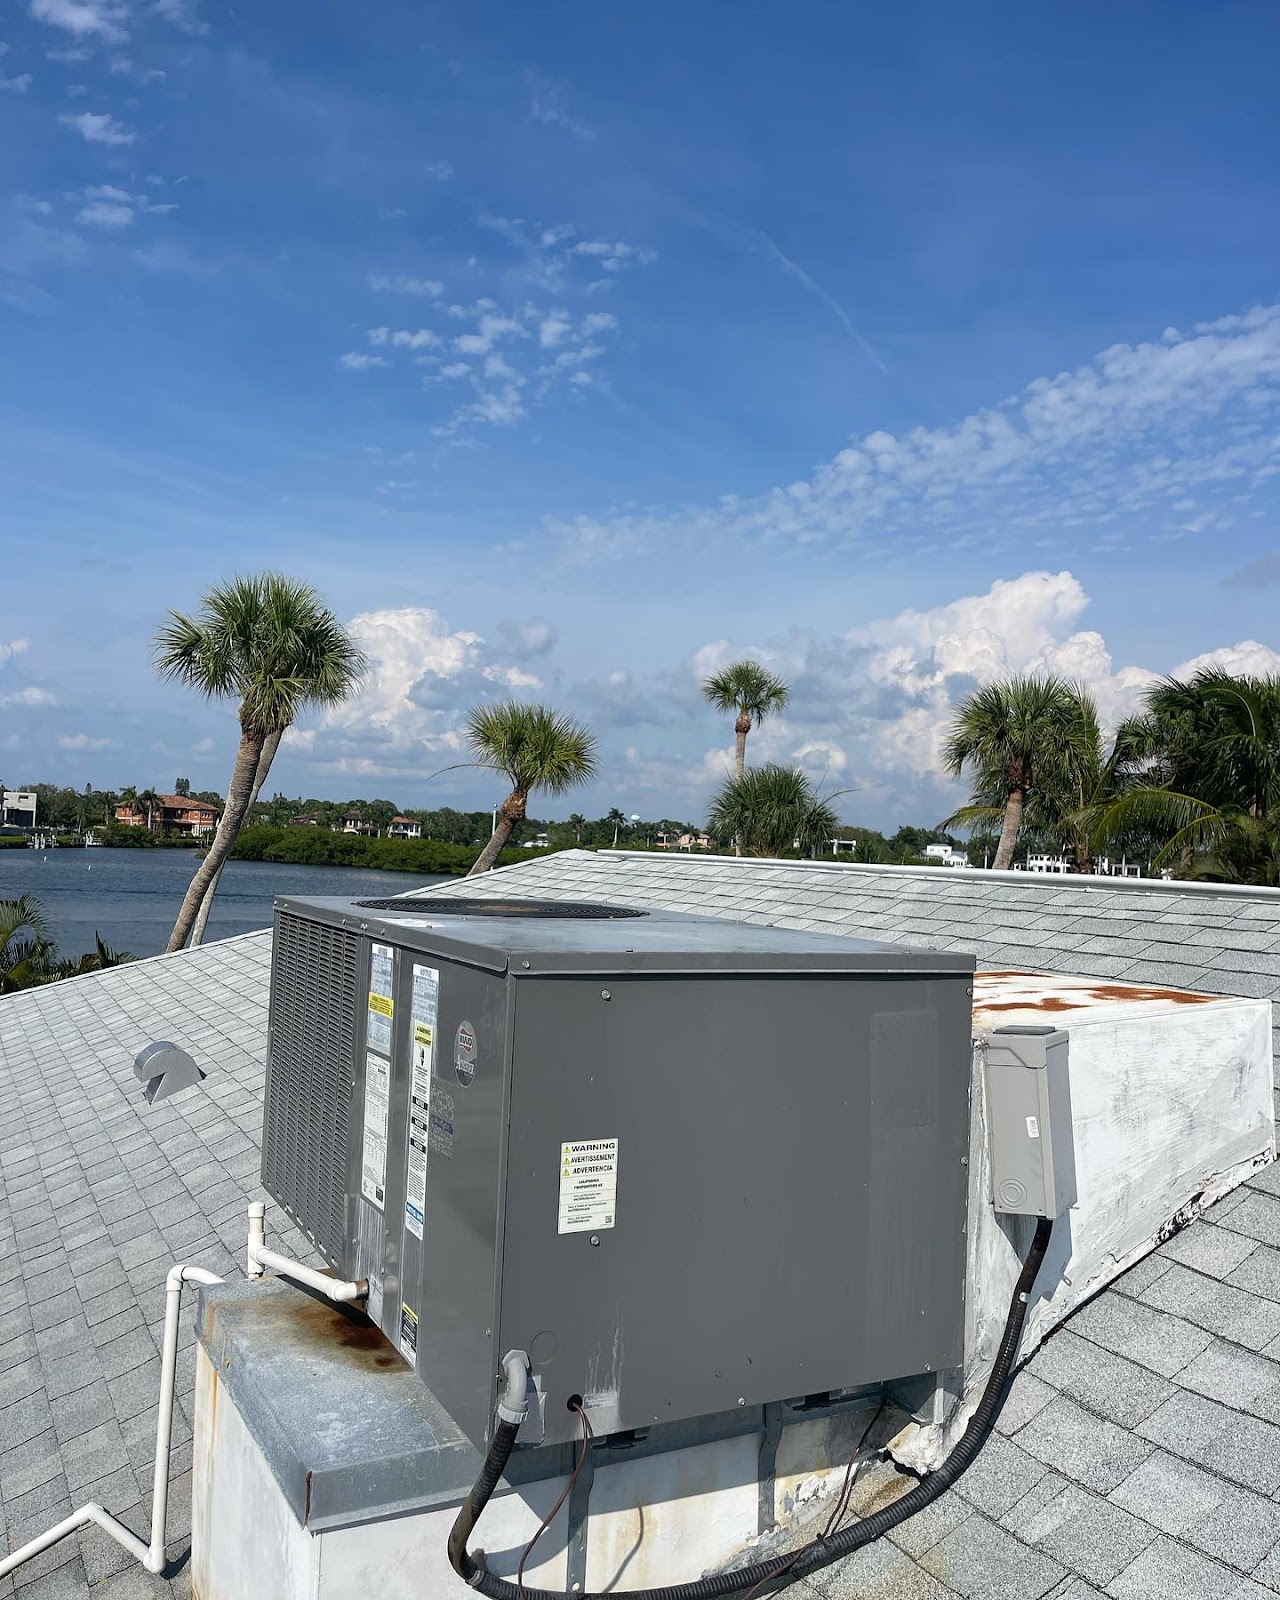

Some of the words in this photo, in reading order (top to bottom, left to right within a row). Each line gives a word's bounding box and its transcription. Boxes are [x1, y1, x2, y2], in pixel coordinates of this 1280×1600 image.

[571, 1142, 615, 1152] WARNING
[571, 1153, 615, 1164] AVERTISSEMENT
[573, 1164, 613, 1174] ADVERTENCIA
